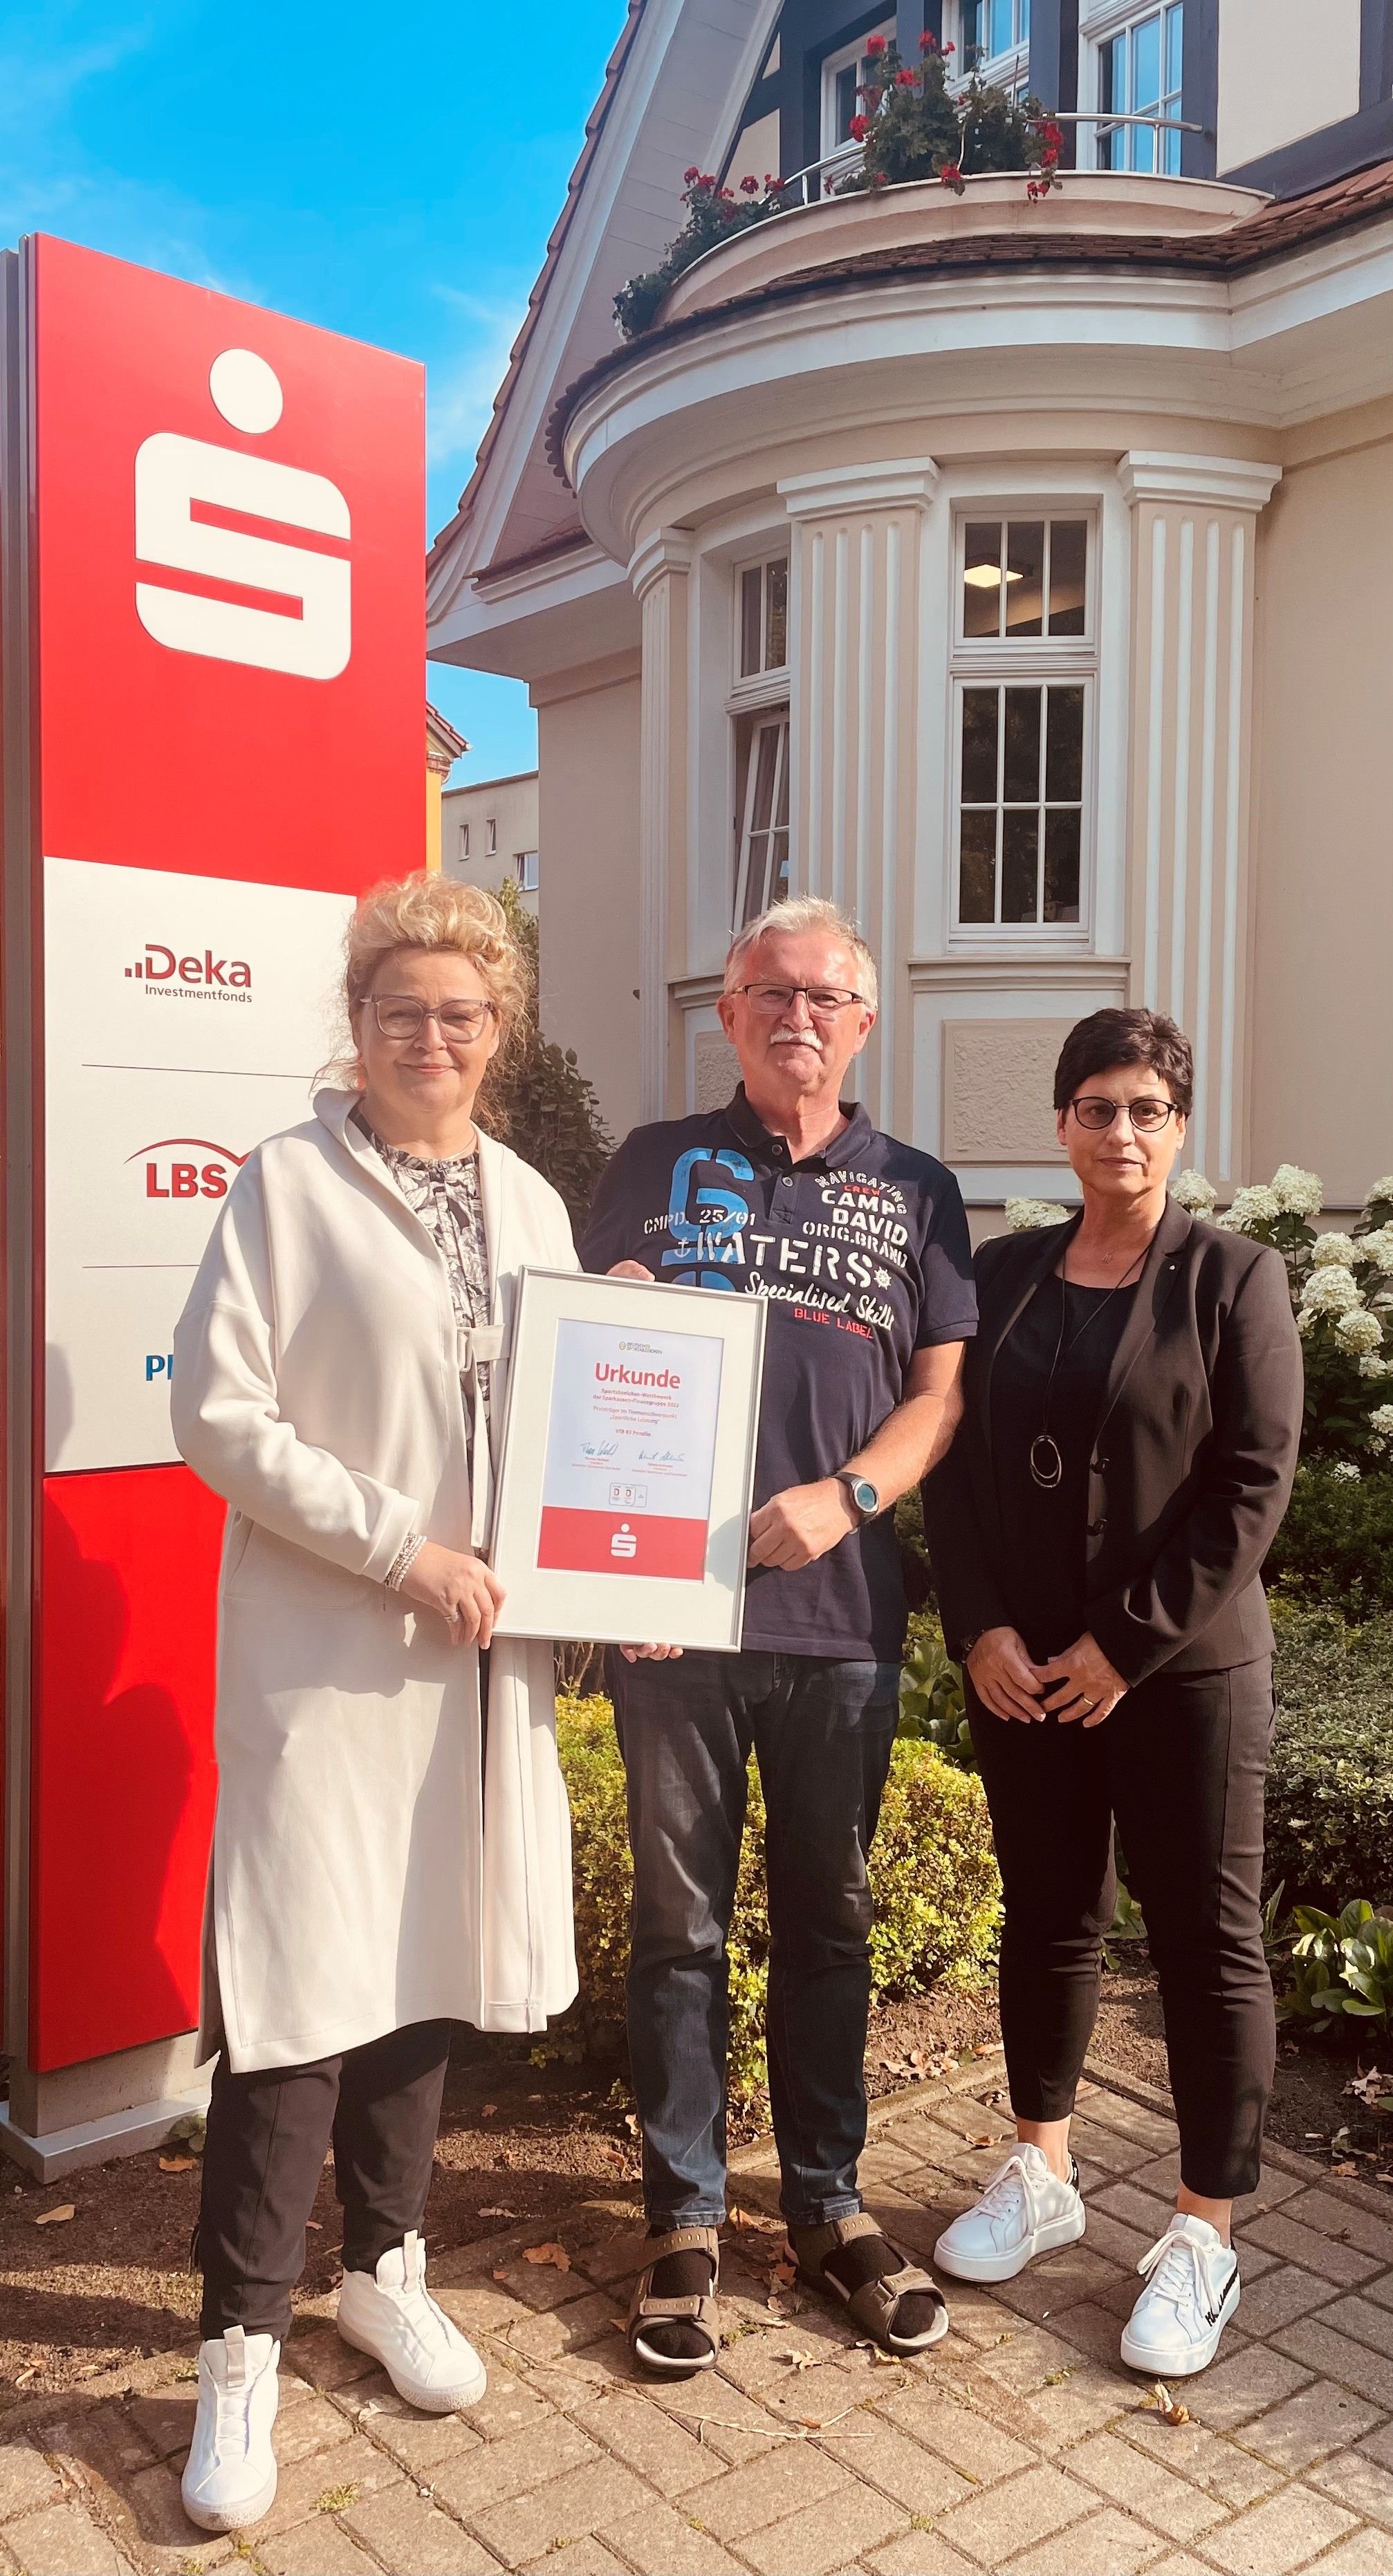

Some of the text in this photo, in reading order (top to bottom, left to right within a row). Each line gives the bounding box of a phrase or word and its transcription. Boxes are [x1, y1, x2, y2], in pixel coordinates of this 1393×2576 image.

[145, 944, 252, 988] Deka
[145, 984, 252, 1003] Investmentfonds
[146, 1162, 228, 1198] LBS
[815, 1171, 907, 1214] NAVIGATING
[843, 1184, 881, 1196] CREW
[821, 1189, 896, 1215] CAMP
[832, 1207, 908, 1245] DAVID
[696, 1232, 873, 1288] WATERS
[744, 1271, 849, 1313] Specialised
[794, 1307, 874, 1340] BLUE LABEL
[596, 1362, 681, 1389] Urkunde
